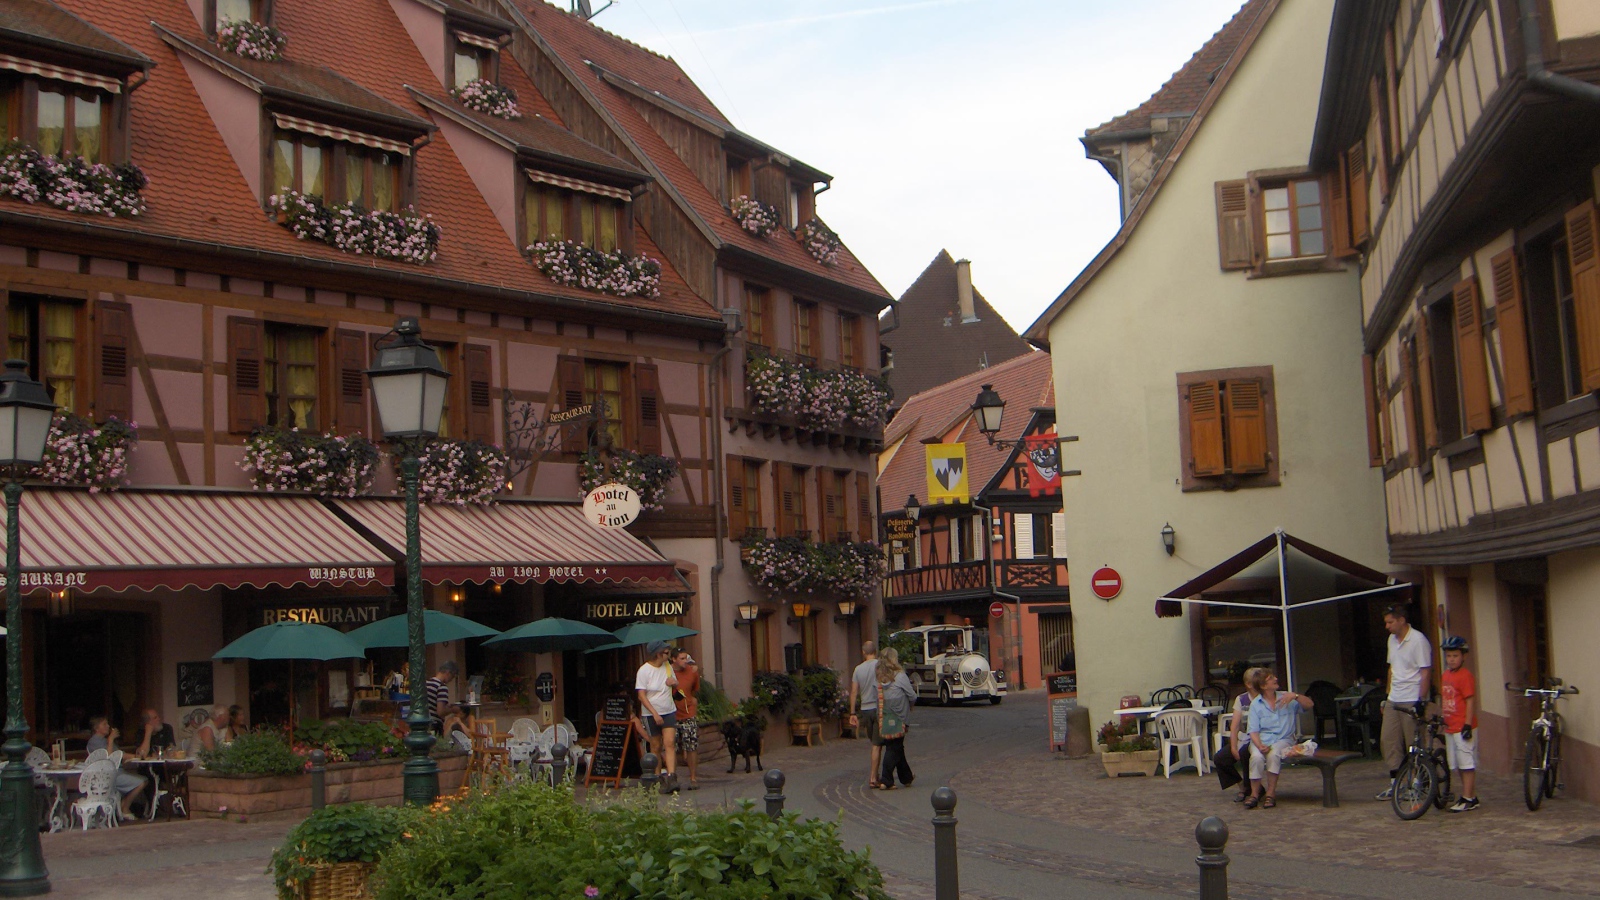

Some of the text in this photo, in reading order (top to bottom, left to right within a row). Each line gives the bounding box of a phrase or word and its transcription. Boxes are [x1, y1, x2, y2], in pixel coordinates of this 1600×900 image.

[593, 490, 629, 506] Hotel
[606, 503, 617, 511] au
[598, 513, 629, 527] Lion
[308, 567, 376, 580] WINSTUB
[489, 566, 505, 578] AU
[512, 566, 541, 578] LION
[263, 606, 379, 625] RESTAURANT
[587, 601, 684, 619] HOTEL AU LION
